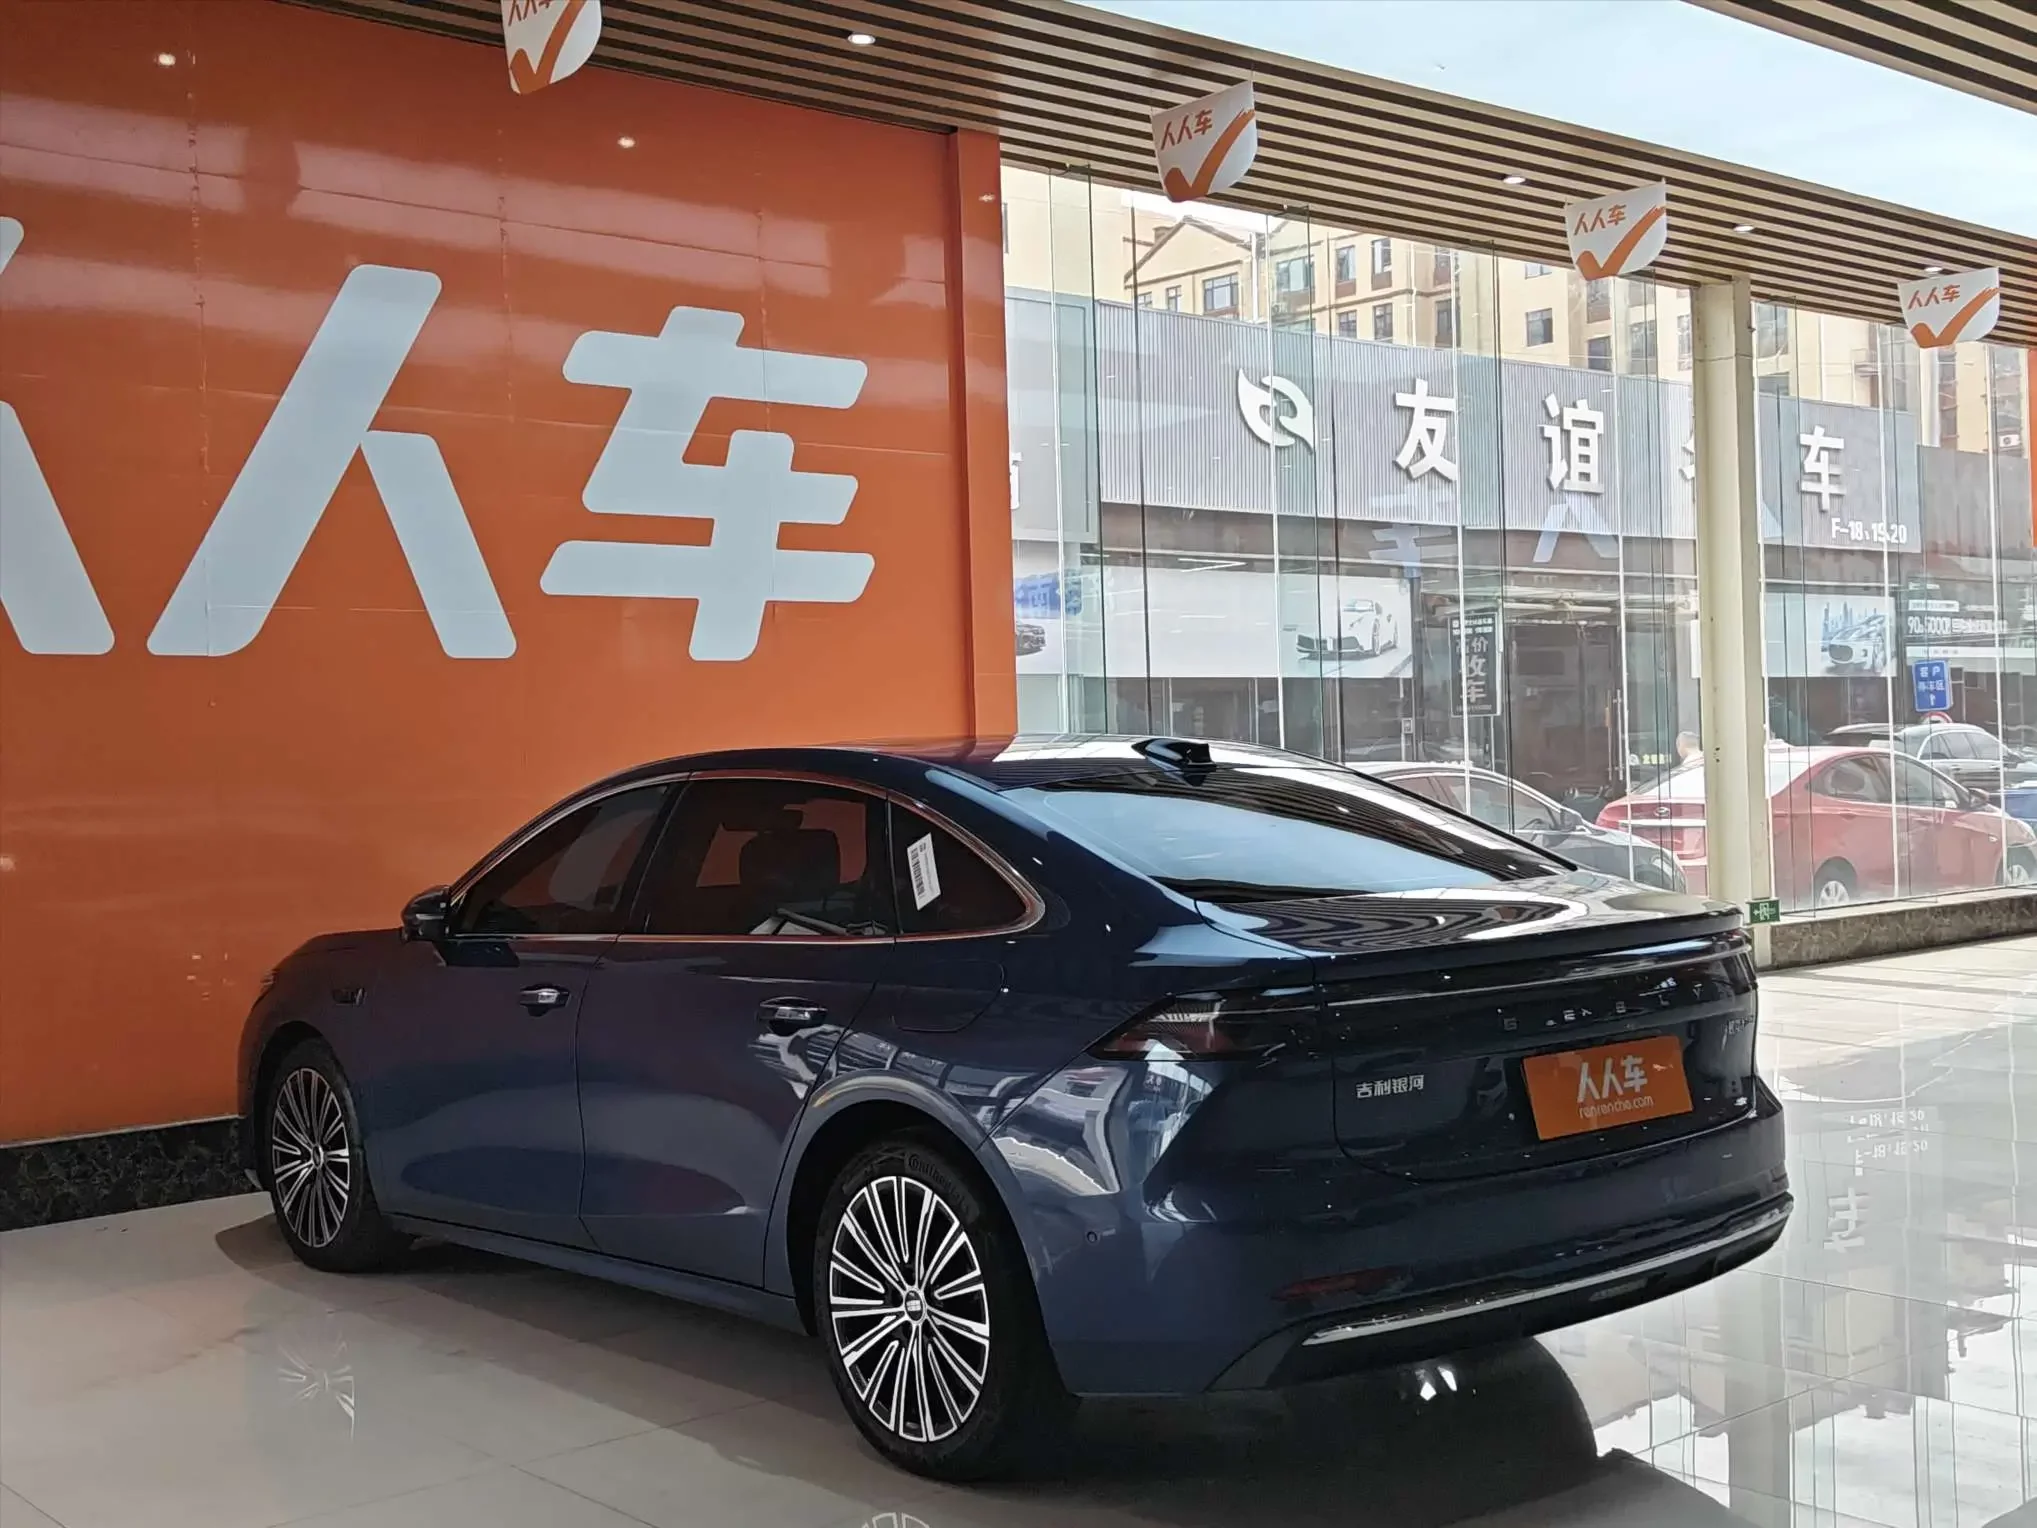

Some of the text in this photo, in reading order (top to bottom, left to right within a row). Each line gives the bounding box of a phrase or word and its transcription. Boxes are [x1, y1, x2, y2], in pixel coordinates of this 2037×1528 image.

[1161, 109, 1213, 151] 人人车
[1574, 204, 1627, 236] 人人车
[1908, 284, 1960, 310] 人人车
[1355, 1074, 1425, 1099] 吉利银河
[1577, 1054, 1648, 1103] 人人车
